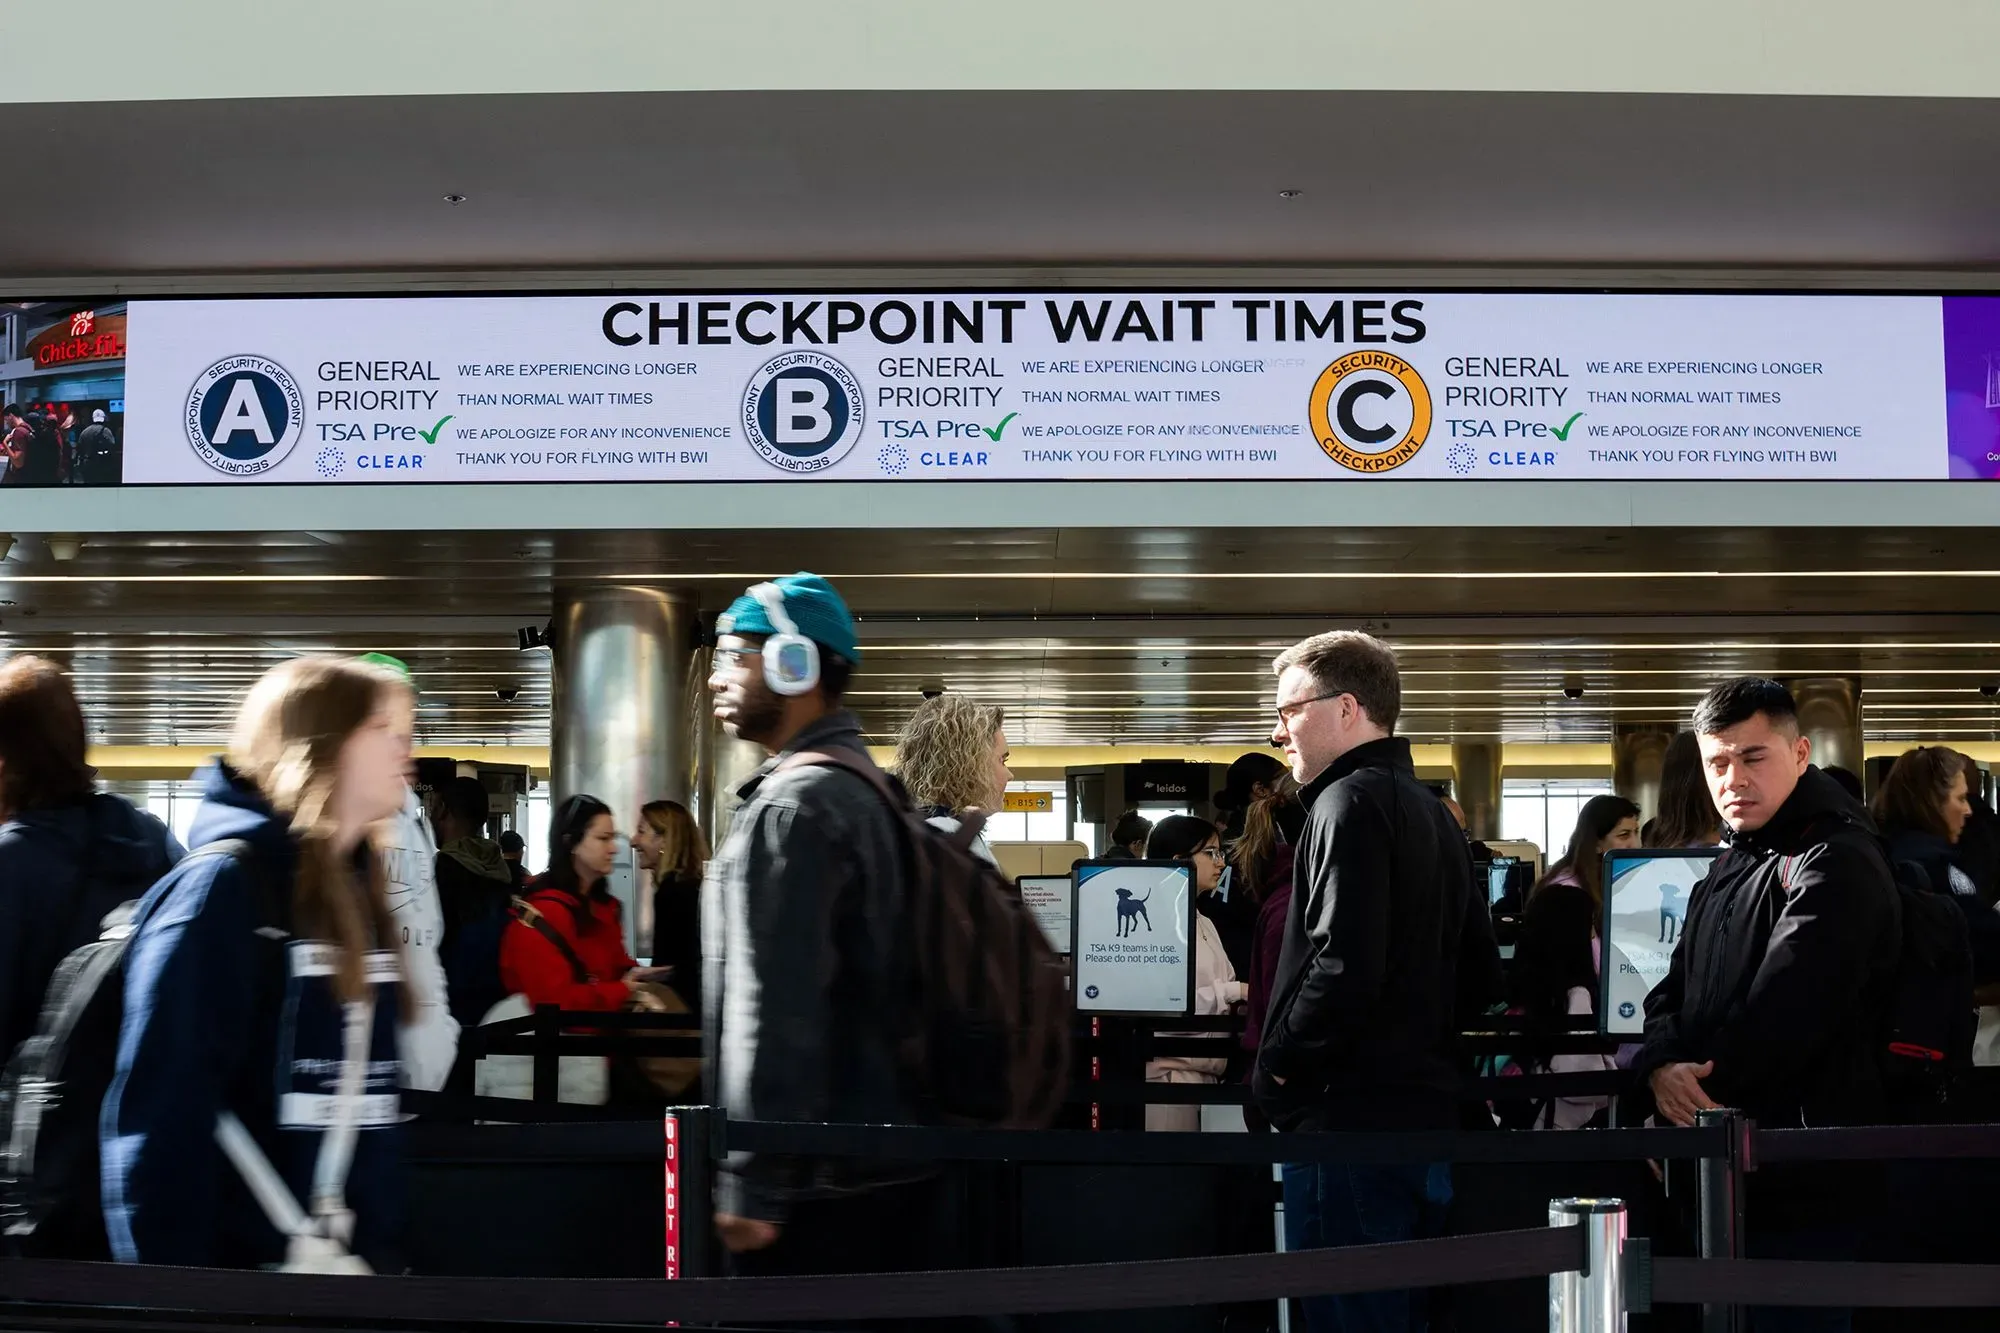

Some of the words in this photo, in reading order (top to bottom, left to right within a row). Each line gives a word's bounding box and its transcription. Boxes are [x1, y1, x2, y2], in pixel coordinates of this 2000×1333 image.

[602, 300, 1026, 346] CHECKPOINT
[1044, 300, 1215, 343] WAIT
[1232, 300, 1426, 344] TIMES
[40, 334, 126, 364] Chick-fil-
[318, 361, 440, 381] GENERAL
[458, 365, 481, 376] WE
[485, 365, 514, 376] ARE
[520, 364, 630, 376] EXPERIENCING
[635, 363, 697, 375] LONGER
[878, 357, 1004, 377] GENERAL
[1022, 362, 1045, 373] WE
[1049, 361, 1079, 373] ARE
[1085, 361, 1196, 373] EXPERIENCING
[1202, 360, 1264, 373] LONGER
[1331, 354, 1408, 378] SECURITY
[1445, 357, 1569, 377] GENERAL
[1586, 362, 1609, 373] WE
[1613, 362, 1643, 373] ARE
[1648, 362, 1757, 374] EXPERIENCING
[1762, 363, 1823, 374] LONGER
[208, 358, 264, 379] SECURITY
[264, 364, 302, 428] CHECKPOINT
[765, 354, 822, 375] SECURITY
[823, 360, 862, 425] CHECKPOINT
[879, 387, 1003, 407] PRIORITY
[1022, 391, 1062, 402] THAN
[1068, 391, 1130, 402] NORMAL
[1134, 391, 1171, 402] WAIT
[1175, 391, 1220, 402] TIMES
[1446, 387, 1568, 407] PRIORITY
[1587, 391, 1626, 403] THAN
[1632, 391, 1694, 403] NORMAL
[1697, 392, 1733, 403] WAIT
[1737, 392, 1781, 403] TIMES
[318, 390, 438, 411] PRIORITY
[457, 394, 496, 405] THAN
[502, 394, 564, 405] NORMAL
[568, 393, 604, 405] WAIT
[608, 393, 653, 404] TIMES
[211, 379, 275, 444] A
[776, 378, 832, 443] B
[1337, 380, 1397, 443] C
[188, 388, 214, 459] CHECKPOINT
[745, 384, 772, 456] CHECKPOINT
[1445, 420, 1496, 437] TSA
[1505, 420, 1547, 437] Pre
[316, 423, 366, 441] TSA
[374, 423, 416, 441] Pre
[457, 429, 477, 439] WE
[480, 429, 556, 439] APOLOGIZE
[561, 428, 587, 438] FOR
[590, 428, 617, 438] ANY
[622, 427, 730, 438] INCONVENIENCE
[878, 420, 928, 438] TSA
[937, 420, 980, 438] Pre
[1022, 426, 1043, 436] WE
[1046, 425, 1122, 436] APOLOGIZE
[1128, 425, 1155, 435] FOR
[1158, 425, 1185, 435] ANY
[1189, 425, 1300, 435] INCONVENIENCE
[1588, 426, 1609, 436] WE
[1612, 426, 1688, 437] APOLOGIZE
[1693, 426, 1720, 436] FOR
[1723, 426, 1749, 437] ANY
[1754, 426, 1861, 437] INCONVENIENCE
[357, 455, 423, 468] CLEAR
[456, 453, 506, 464] THANK
[510, 453, 541, 464] YOU
[547, 453, 577, 464] FOR
[582, 452, 633, 464] FLYING
[638, 452, 675, 463] WITH
[681, 452, 707, 463] BWI
[920, 452, 988, 466] CLEAR
[1022, 450, 1072, 461] THANK
[1077, 450, 1108, 461] YOU
[1114, 450, 1144, 461] FOR
[1150, 450, 1202, 461] FLYING
[1206, 450, 1244, 461] WITH
[1249, 450, 1276, 461] BWI
[1322, 436, 1419, 470] CHECKPOINT
[1489, 452, 1555, 466] CLEAR
[1588, 450, 1638, 462] THANK
[1642, 450, 1673, 462] YOU
[1679, 450, 1709, 462] FOR
[1714, 450, 1764, 462] FLYING
[1768, 451, 1805, 462] WITH
[1810, 451, 1836, 462] BWI
[1987, 452, 2000, 461] Co
[212, 457, 269, 473] SECURITY
[771, 454, 830, 471] SECURITY
[1156, 783, 1187, 793] leidos
[1017, 799, 1034, 807] B15
[1091, 944, 1106, 953] TSA
[1108, 944, 1121, 953] K9
[1122, 944, 1148, 953] teams
[1150, 944, 1158, 953] in
[1160, 945, 1177, 953] use.
[1085, 954, 1112, 963] Please
[1114, 954, 1126, 963] do
[1127, 955, 1141, 963] not
[1143, 955, 1157, 964] pet
[1159, 954, 1181, 964] dogs.
[666, 1122, 675, 1160] DO
[667, 1172, 675, 1231] NOT
